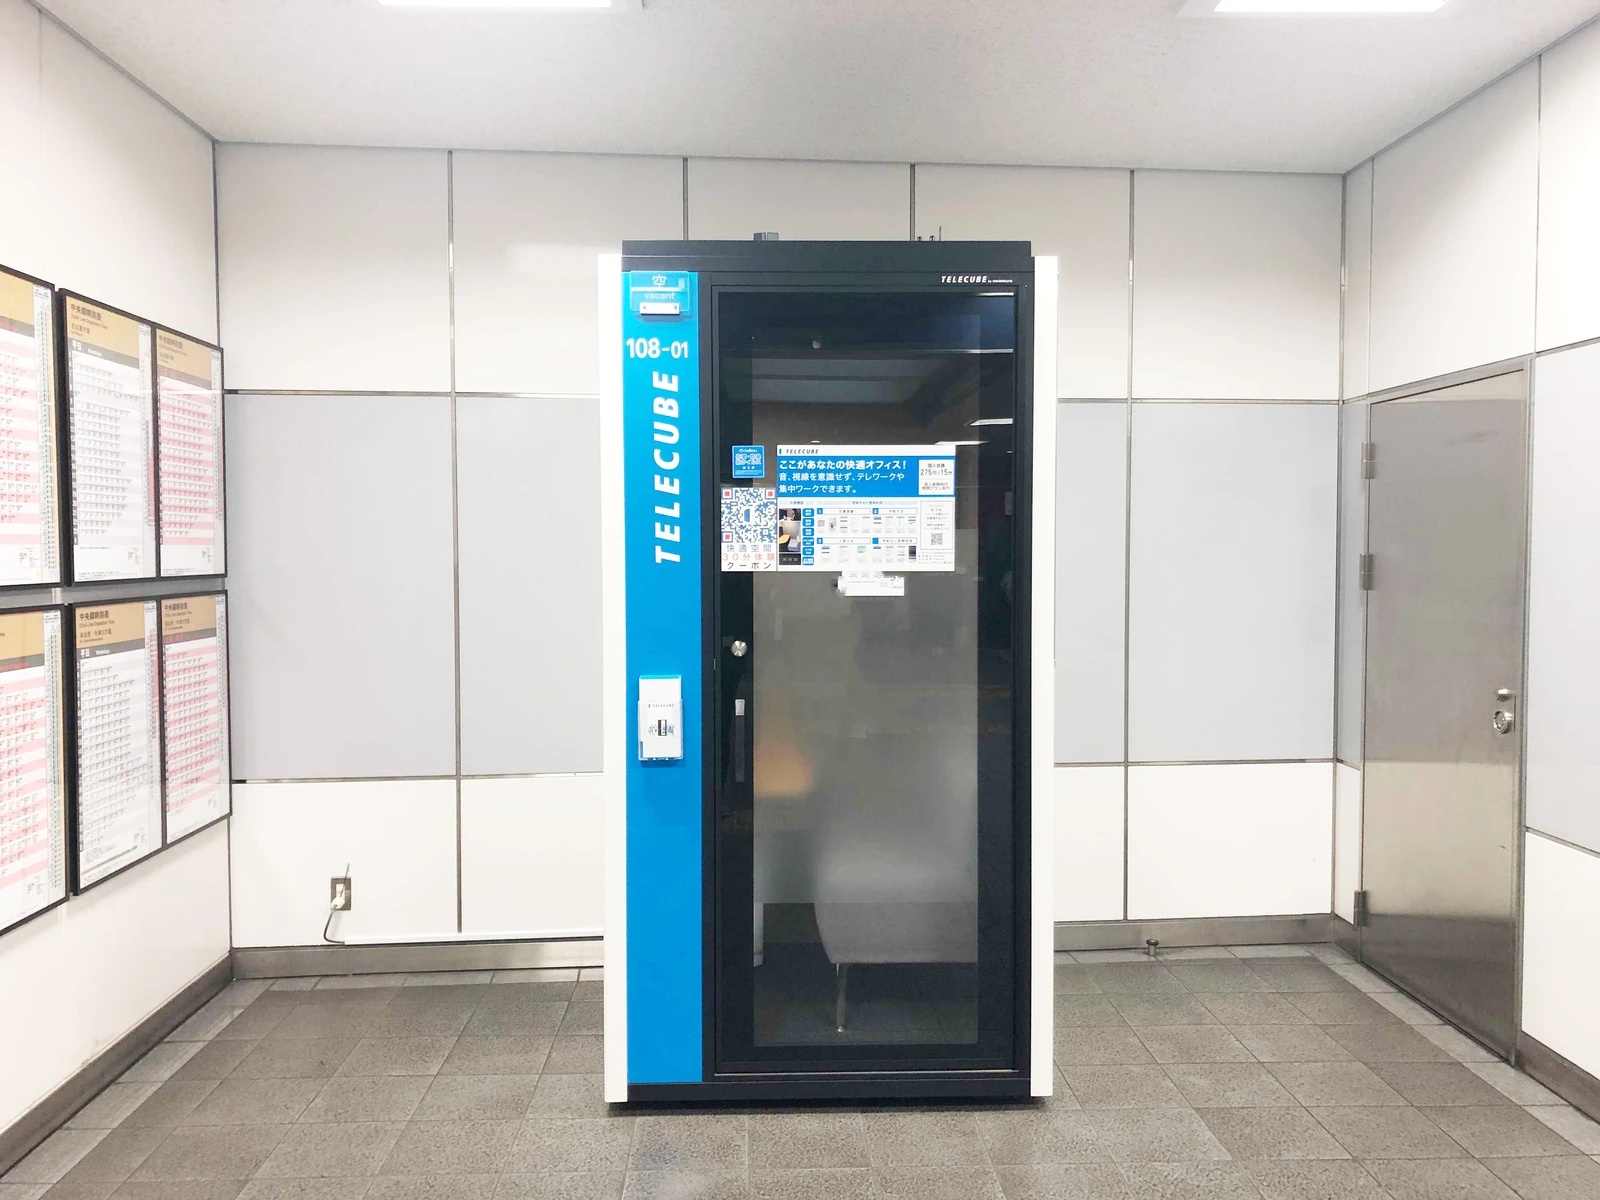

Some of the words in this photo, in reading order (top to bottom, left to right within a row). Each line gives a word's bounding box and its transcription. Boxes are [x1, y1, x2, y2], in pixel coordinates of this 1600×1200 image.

[652, 274, 666, 288] 空
[941, 276, 988, 284] TELECUBE
[626, 338, 688, 359] 108-01
[652, 371, 681, 564] TELECUBE
[779, 472, 905, 482] 音、視線を意識せず、テレワークや
[779, 484, 856, 494] 集中ワークできます。
[80, 648, 90, 658] 平日
